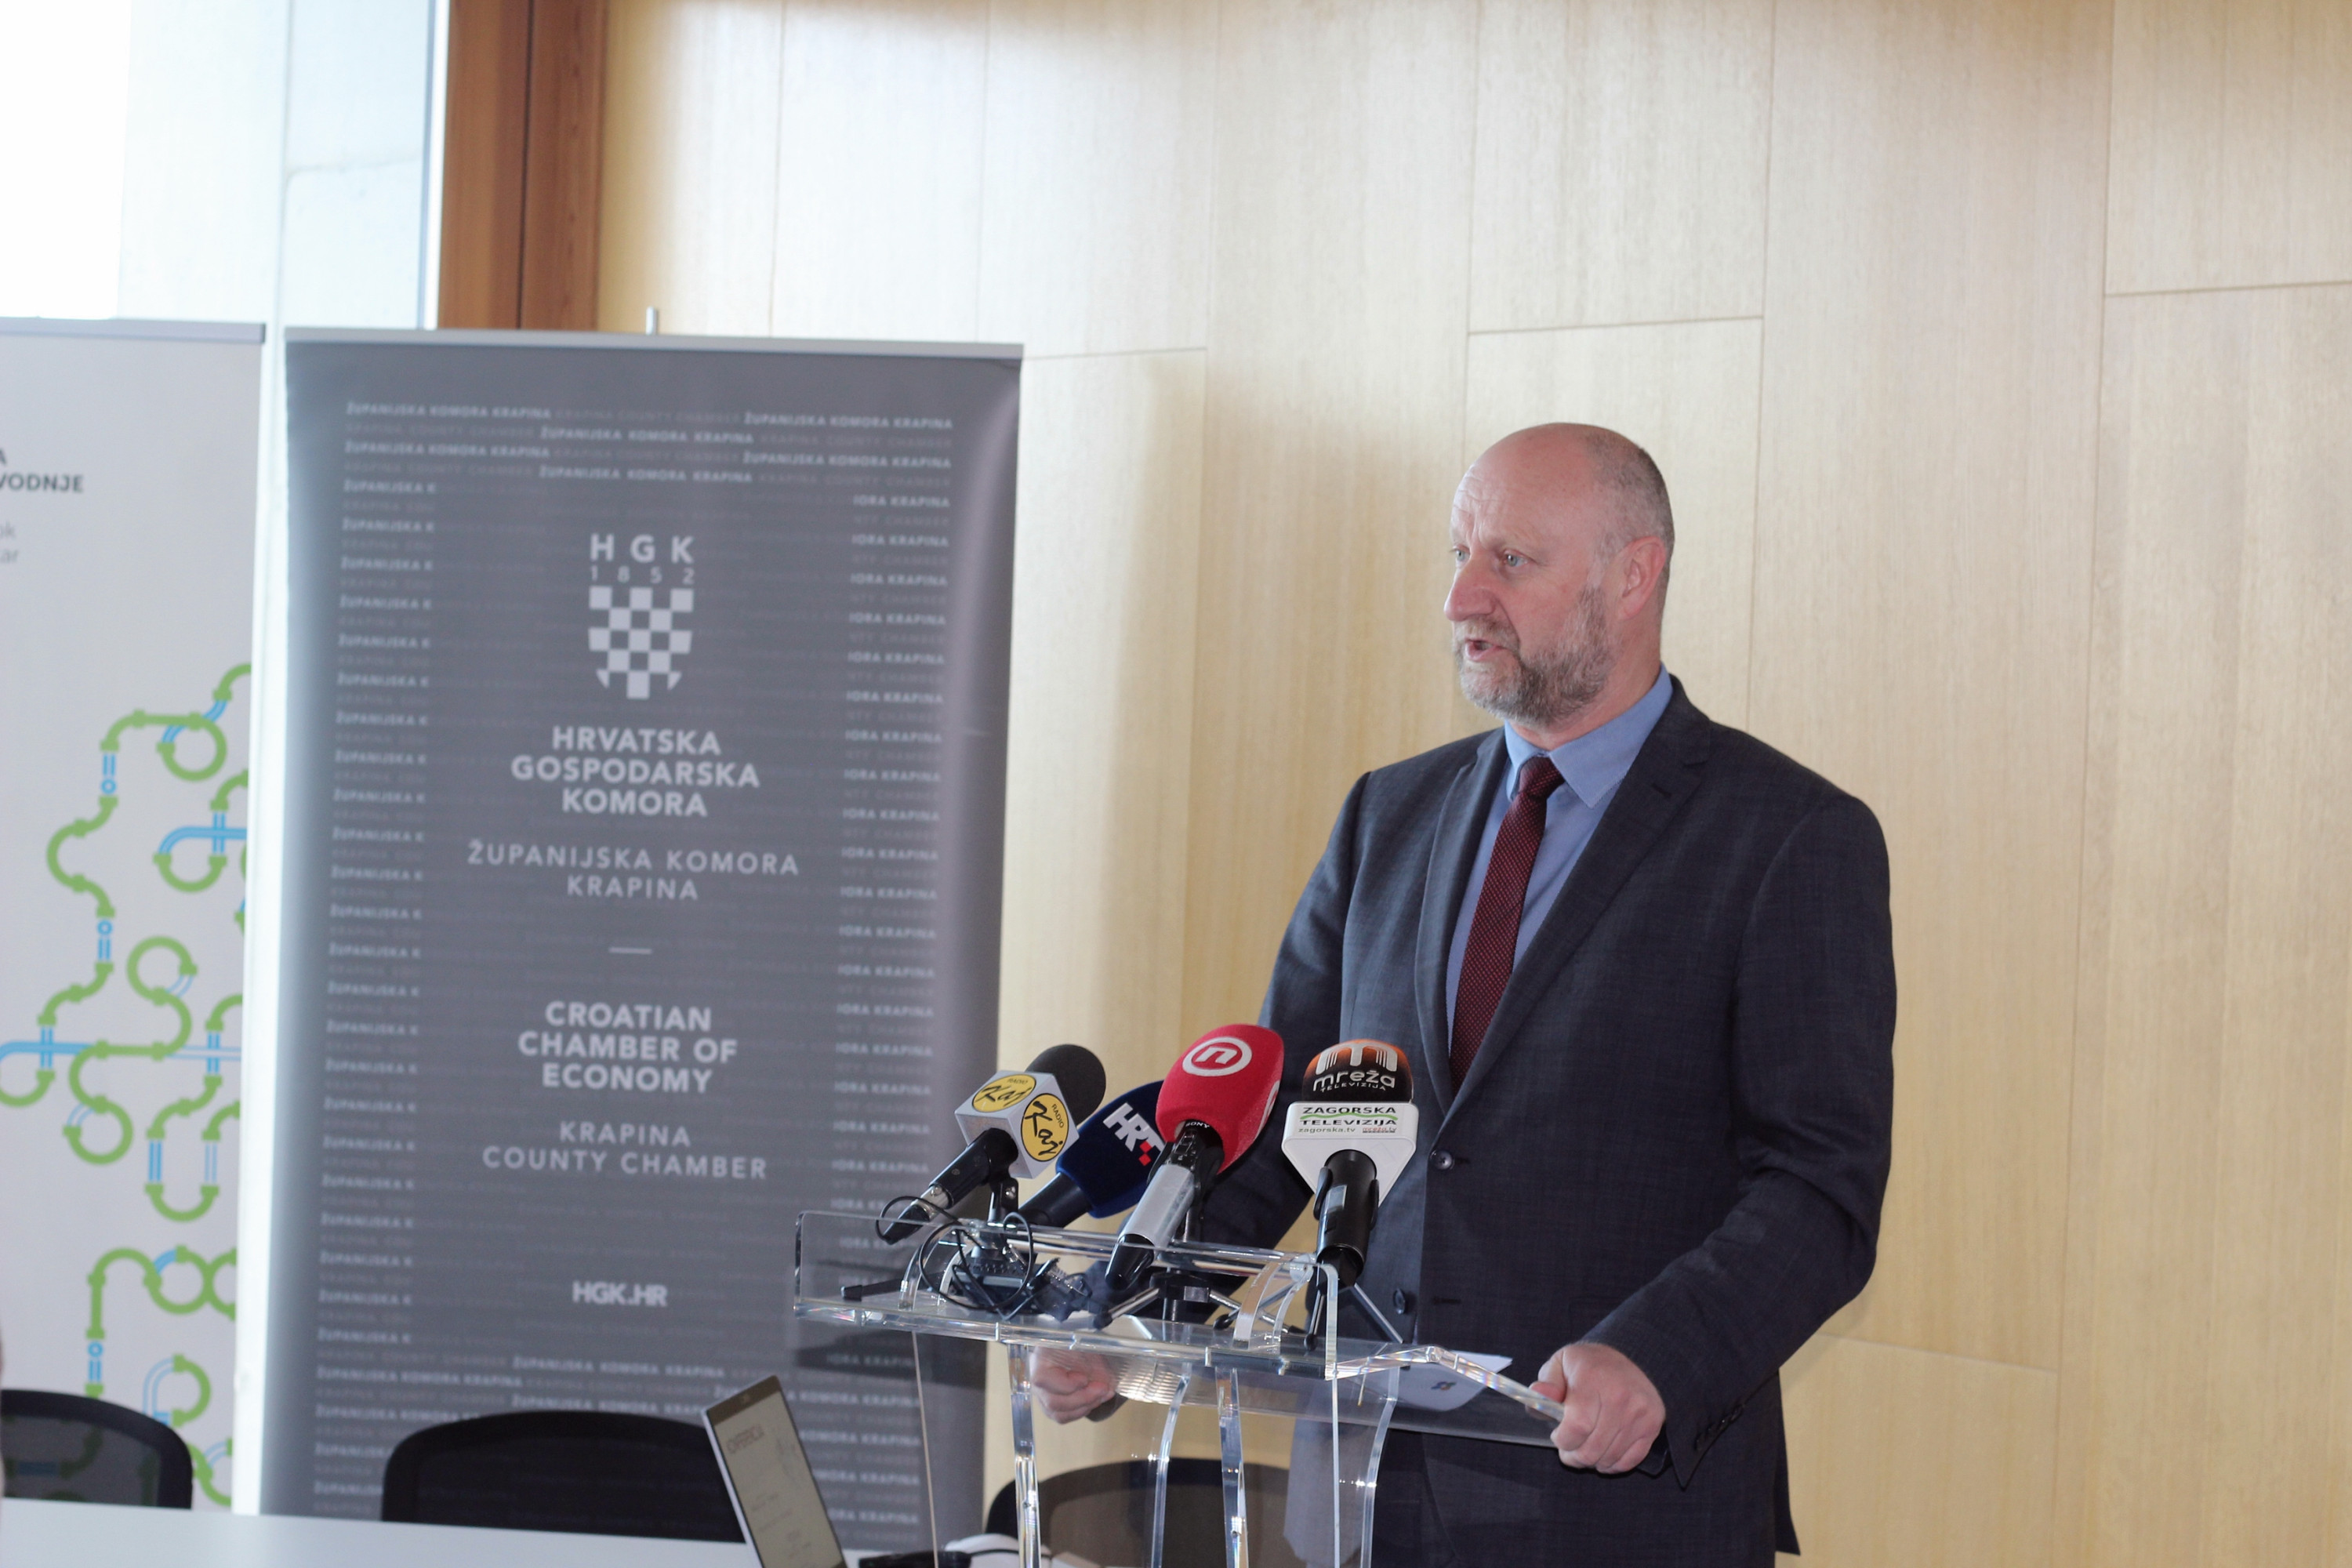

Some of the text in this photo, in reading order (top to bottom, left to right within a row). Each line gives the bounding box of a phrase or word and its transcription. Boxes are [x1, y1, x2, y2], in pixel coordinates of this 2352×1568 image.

[552, 726, 720, 755] HRVATSKA
[510, 754, 760, 788] GOSPODARSKA
[562, 788, 707, 817] KOMORA
[467, 839, 798, 875] ŽUPANIJSKA KOMORA
[568, 875, 699, 900] KRAPINA
[545, 1000, 711, 1031] CROATIAN
[517, 1031, 738, 1063] CHAMBER OF
[543, 1063, 712, 1094] ECONOMY
[1313, 1070, 1395, 1091] mreža
[1051, 1104, 1064, 1128] RADIO
[1103, 1102, 1166, 1152] HRT
[560, 1121, 690, 1147] KRAPINA
[482, 1145, 767, 1179] COUNTY CHAMBER
[573, 1281, 667, 1307] HGK.HR
